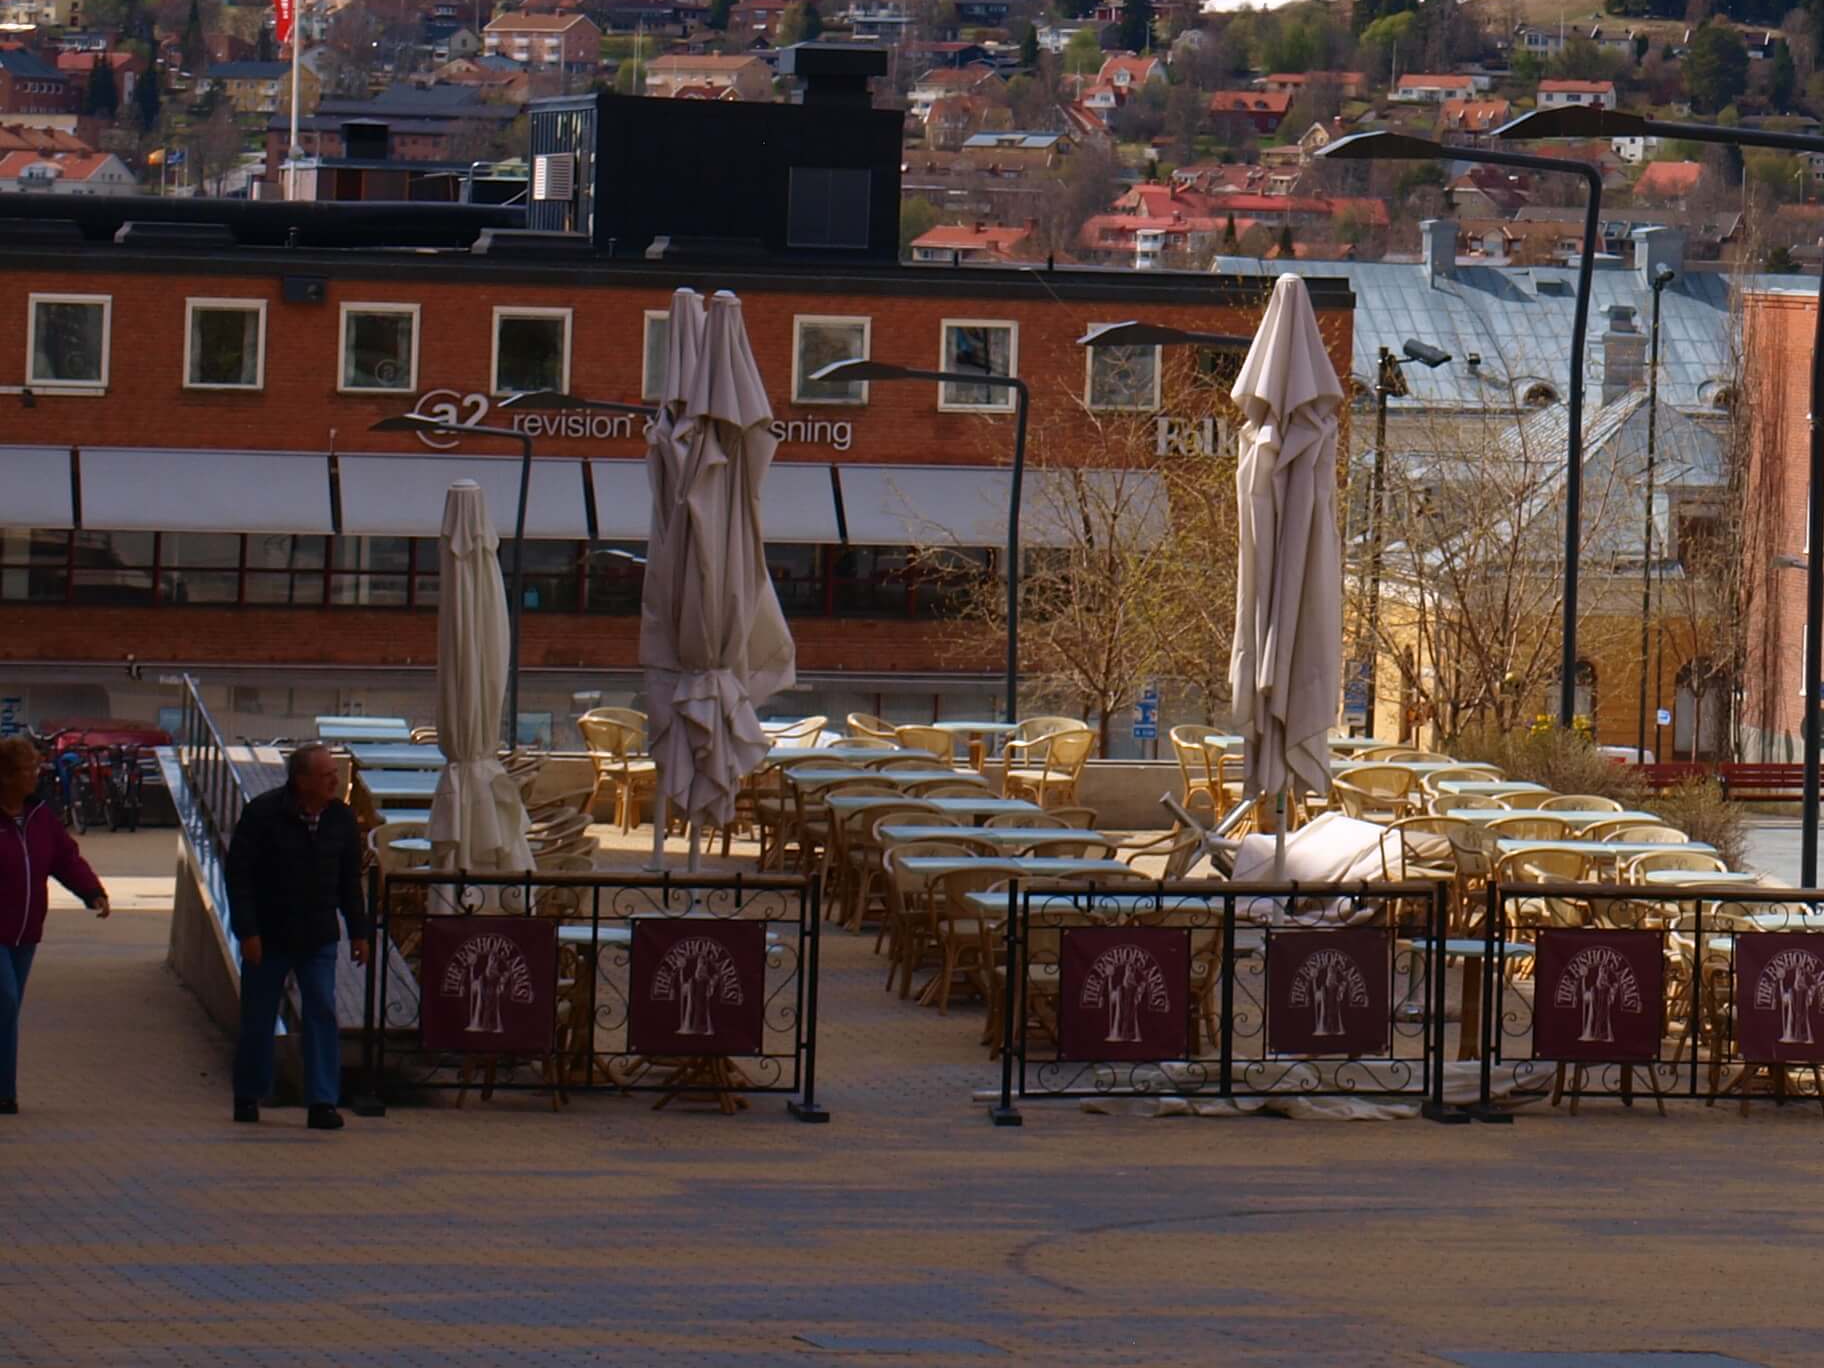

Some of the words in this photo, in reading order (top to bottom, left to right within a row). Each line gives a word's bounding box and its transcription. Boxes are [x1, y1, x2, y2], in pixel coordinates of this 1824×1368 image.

[512, 409, 631, 438] revision
[444, 962, 464, 992] THE
[456, 936, 514, 968] BISHOPS
[505, 955, 531, 999] ARMS
[653, 966, 674, 995] THE
[664, 940, 722, 971] BISHOPS
[715, 958, 739, 1000] ARMS
[1082, 974, 1104, 1003] THE
[1093, 948, 1151, 978] BISHOPS
[1143, 965, 1166, 1007] ARMS
[1299, 951, 1349, 980] BISHOPS
[1567, 950, 1623, 978] BISHOPS
[1766, 952, 1819, 982] BISHOPS
[1290, 977, 1309, 1004] THE
[1342, 967, 1365, 1002] ARMS
[1557, 975, 1578, 1003] THE
[1614, 967, 1640, 1008] ARMS
[1757, 977, 1777, 1005] THE
